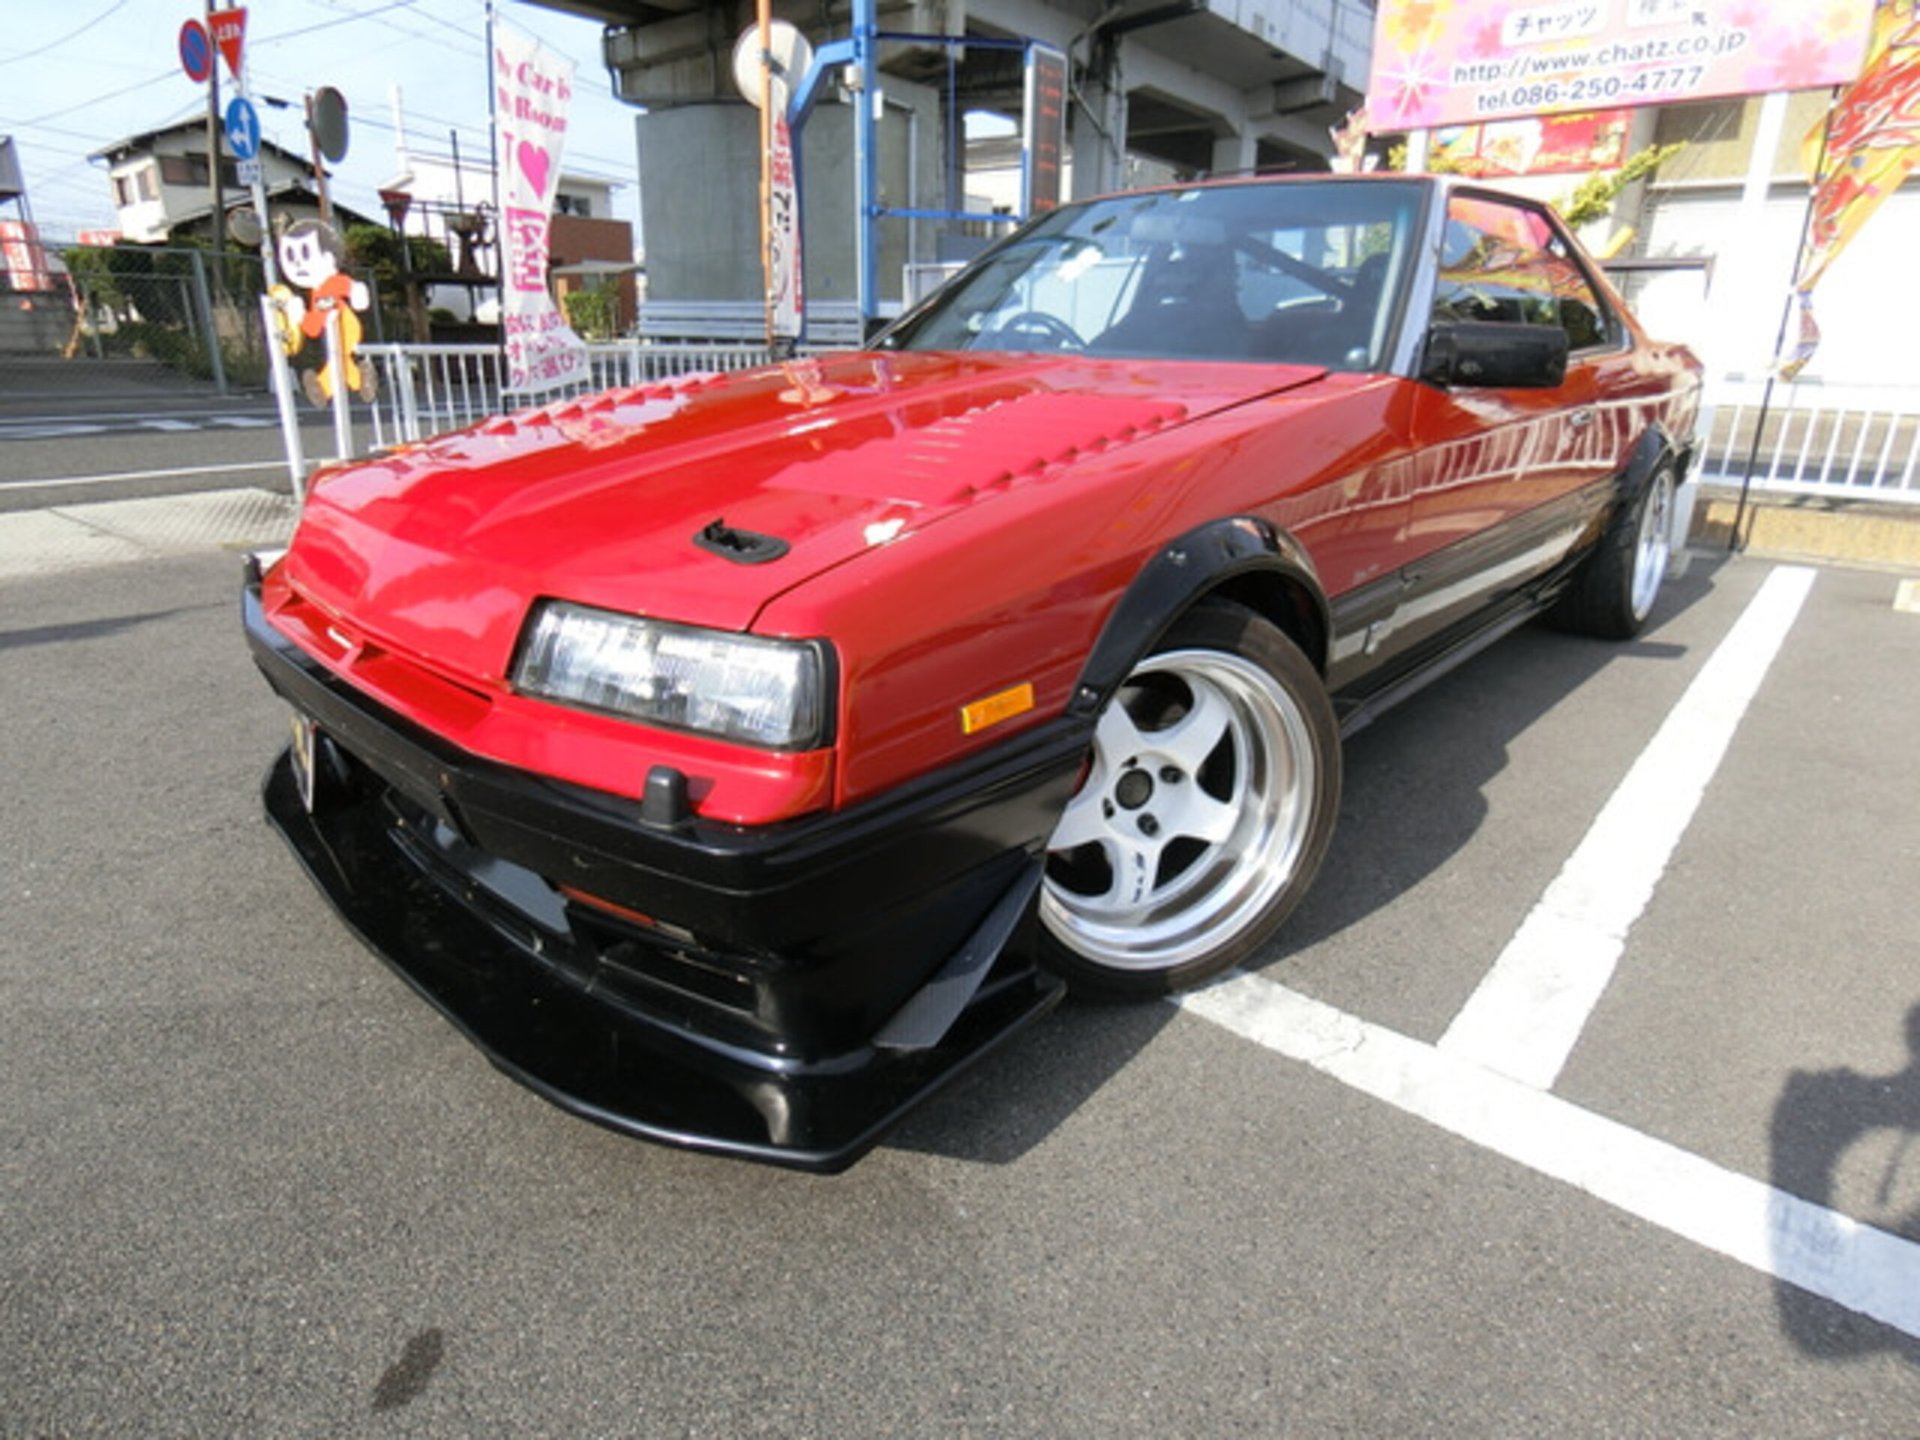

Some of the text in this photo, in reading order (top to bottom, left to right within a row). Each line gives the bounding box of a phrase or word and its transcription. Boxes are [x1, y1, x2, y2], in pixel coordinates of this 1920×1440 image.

[1514, 5, 1598, 37] チャッツ
[1453, 31, 1746, 83] http://www.chatz.co.jp
[1477, 65, 1704, 111] tel.086-250-4777
